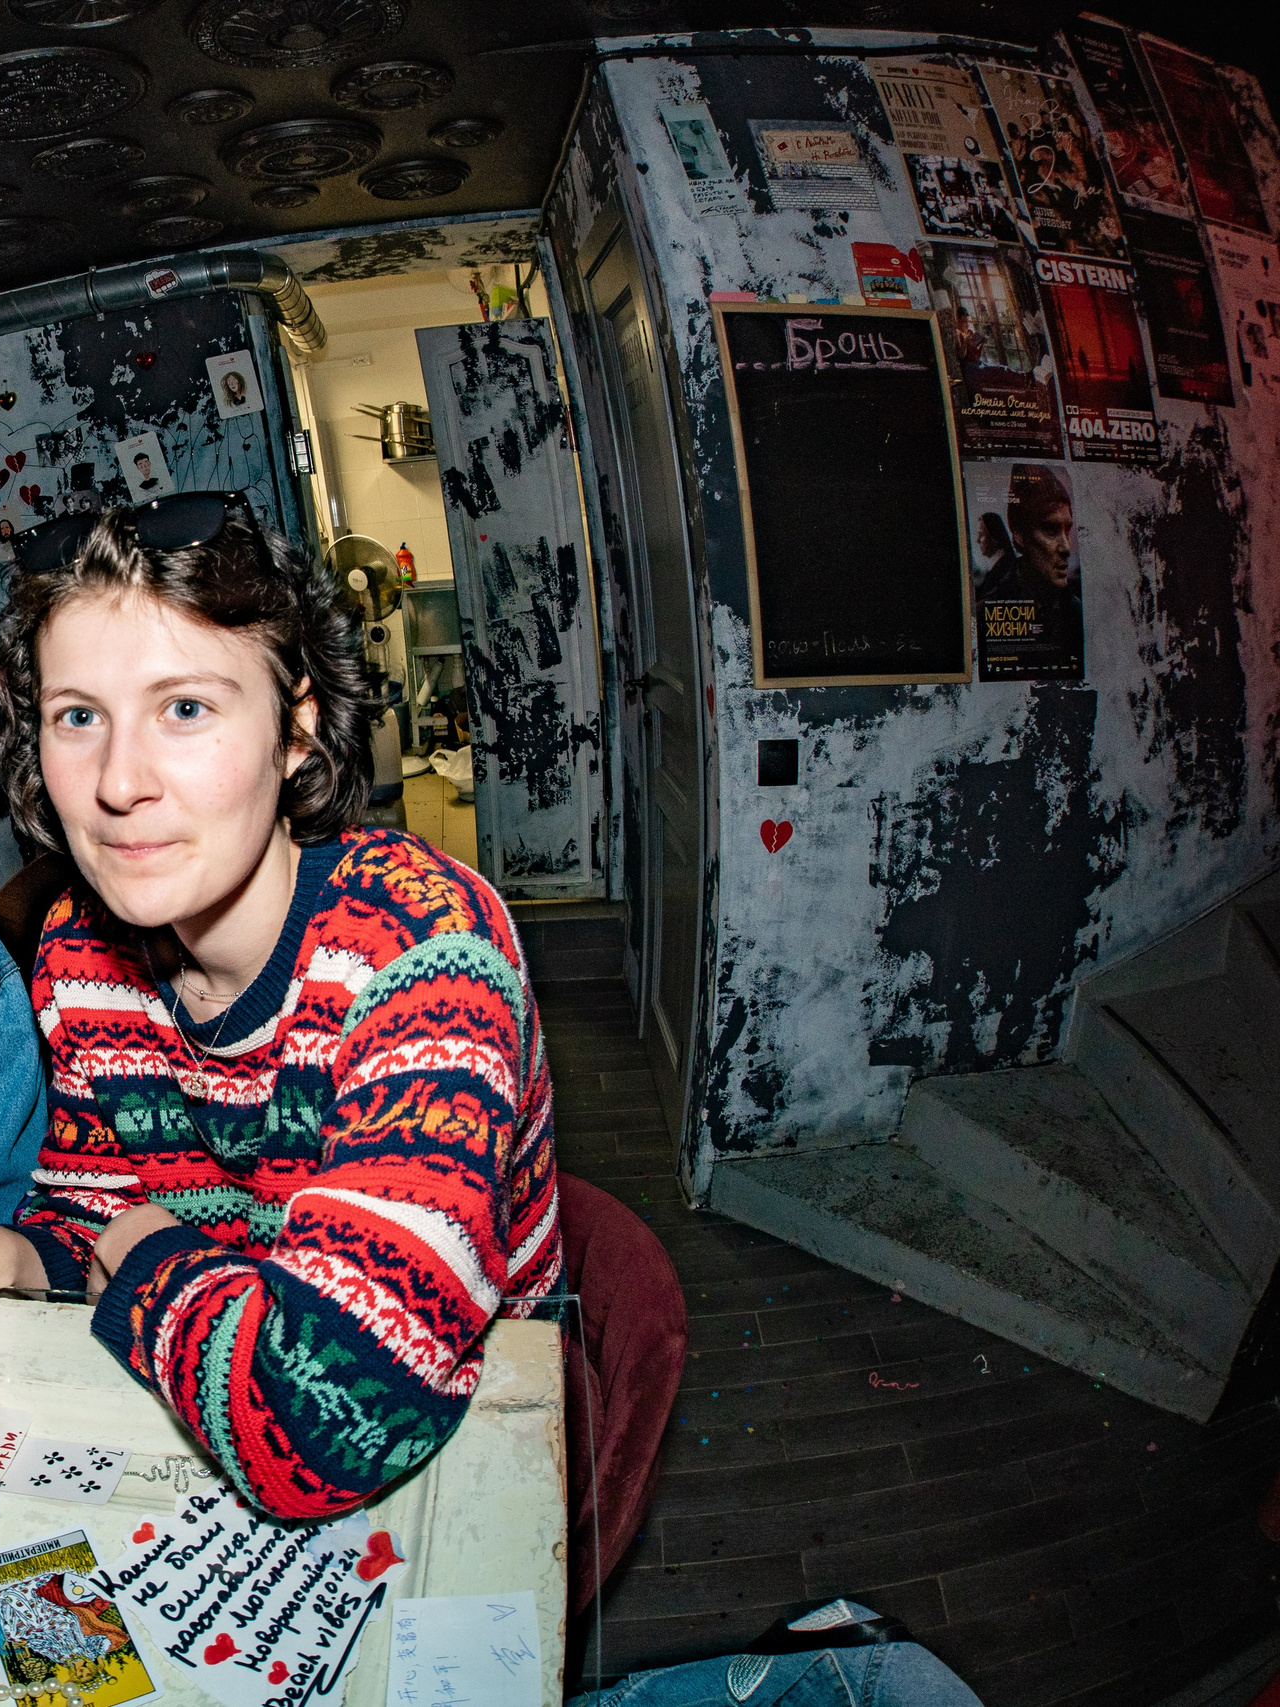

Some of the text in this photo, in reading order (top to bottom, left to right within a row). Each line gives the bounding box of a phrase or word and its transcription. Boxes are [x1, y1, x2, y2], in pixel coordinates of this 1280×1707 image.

[880, 81, 935, 109] PARTY
[1035, 258, 1127, 292] CISTERN
[786, 319, 904, 371] Бронь
[961, 407, 1008, 418] испортила
[1007, 394, 1039, 410] Остин
[1069, 417, 1156, 443] 404.ZERO
[984, 606, 1036, 621] МЕЛОЧИ
[985, 622, 1028, 637] ЖИЗНИ
[89, 1534, 175, 1599] Какими
[131, 1580, 169, 1607] не
[312, 1548, 361, 1615] 08.01.24
